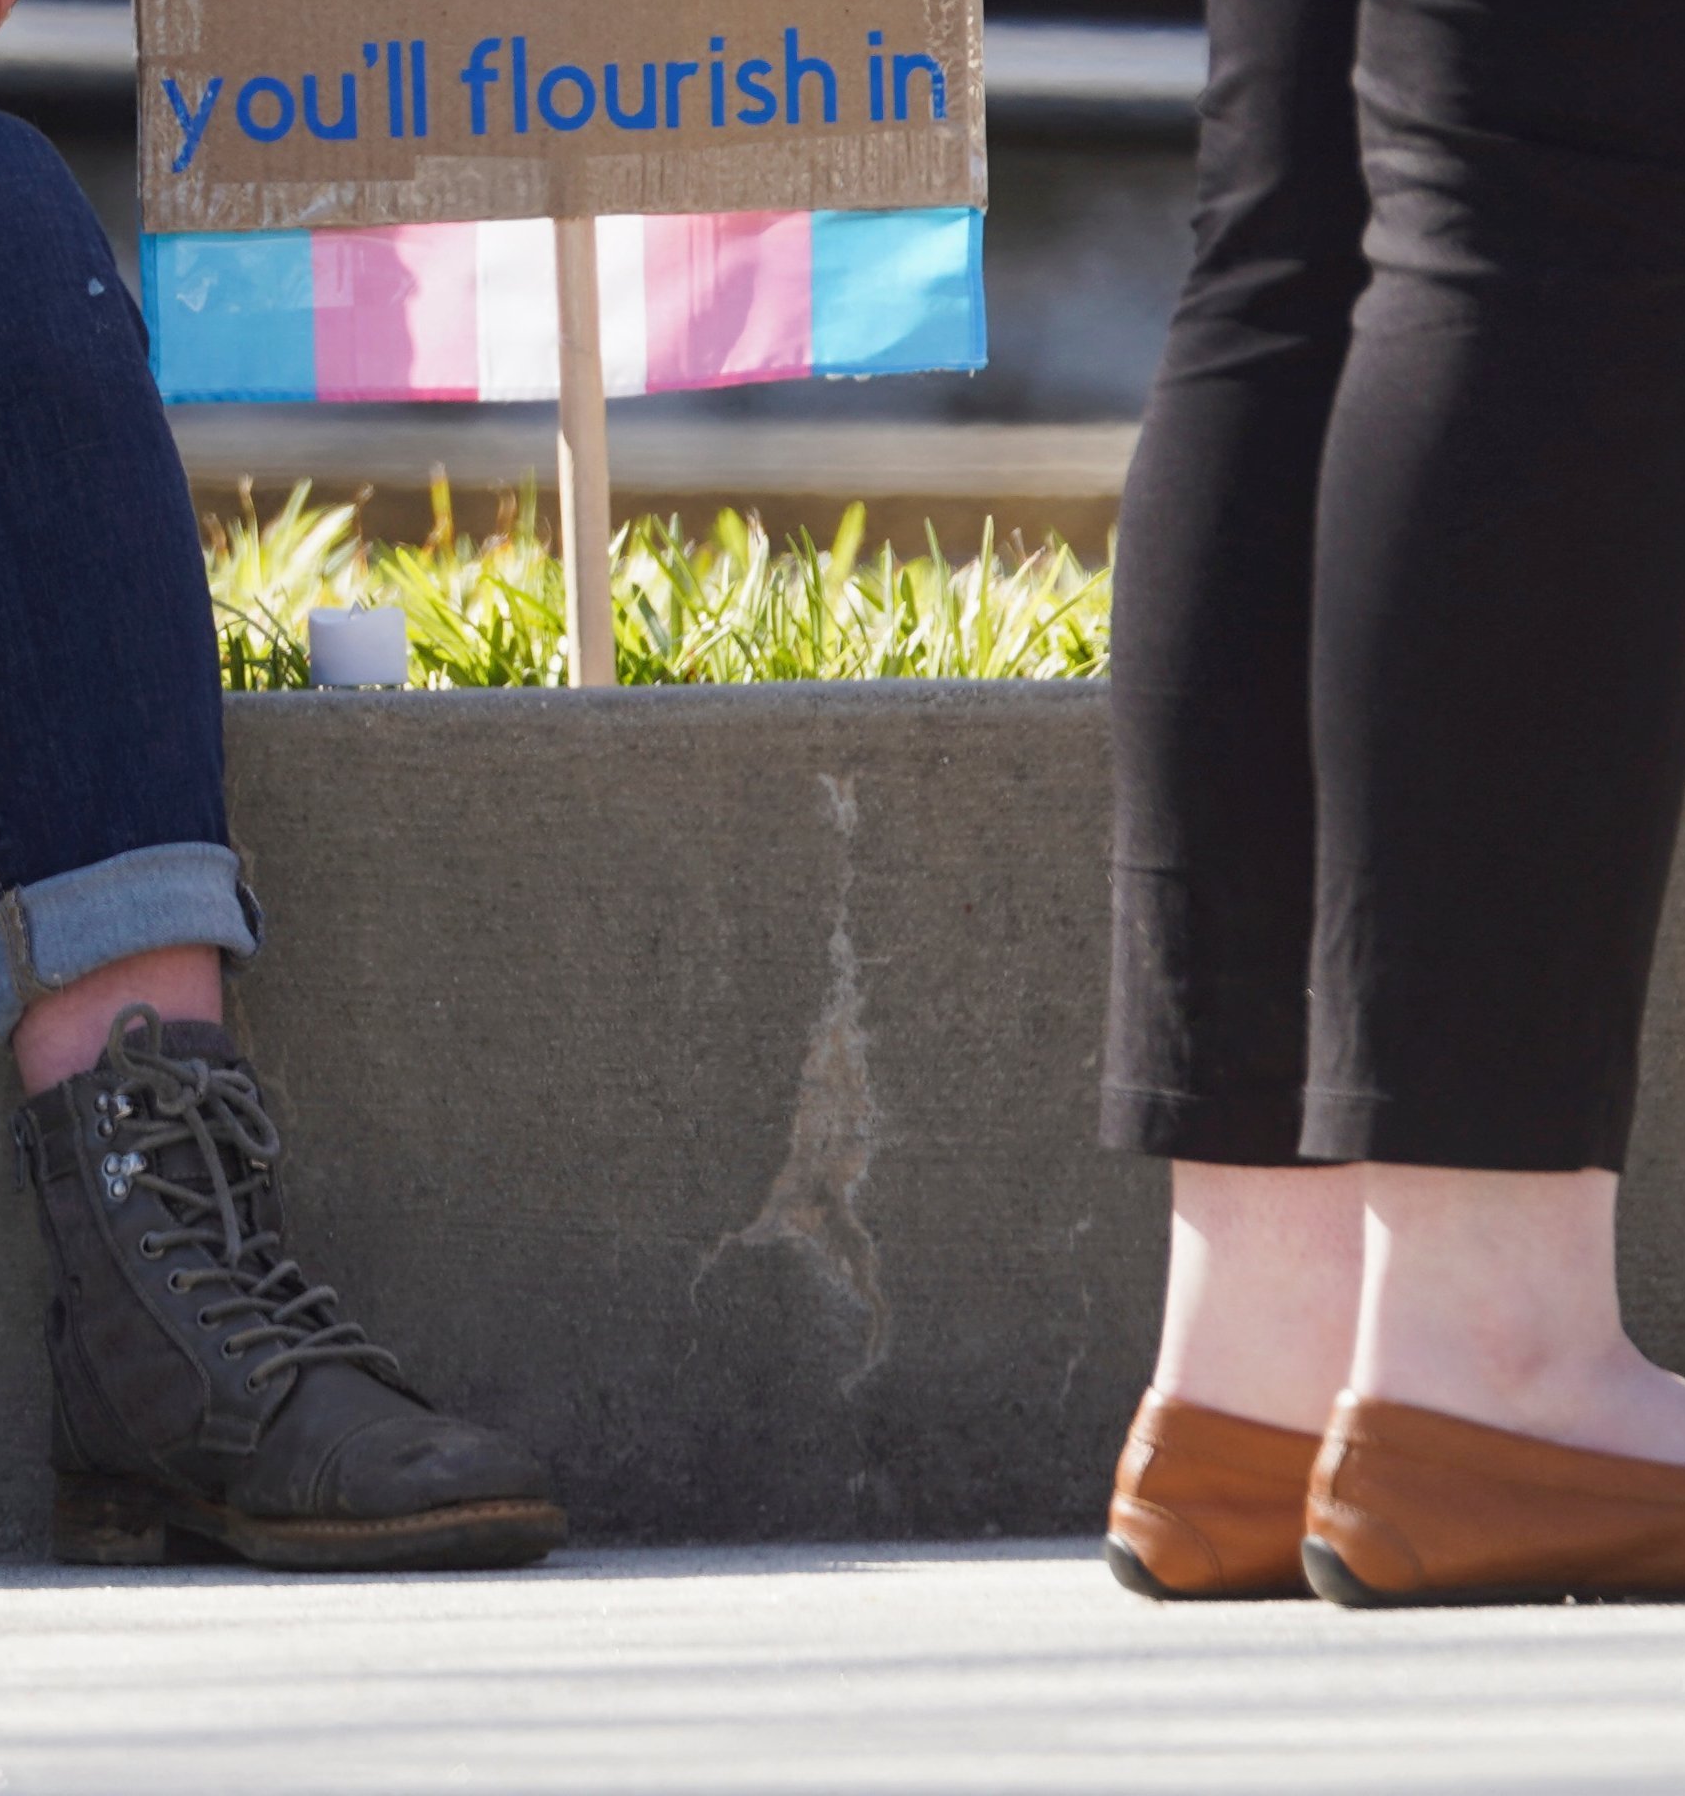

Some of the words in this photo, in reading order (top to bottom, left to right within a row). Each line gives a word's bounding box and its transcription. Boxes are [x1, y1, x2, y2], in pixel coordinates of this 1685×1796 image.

[161, 39, 430, 175] you'll
[459, 27, 841, 137] flourish
[866, 30, 950, 124] in
